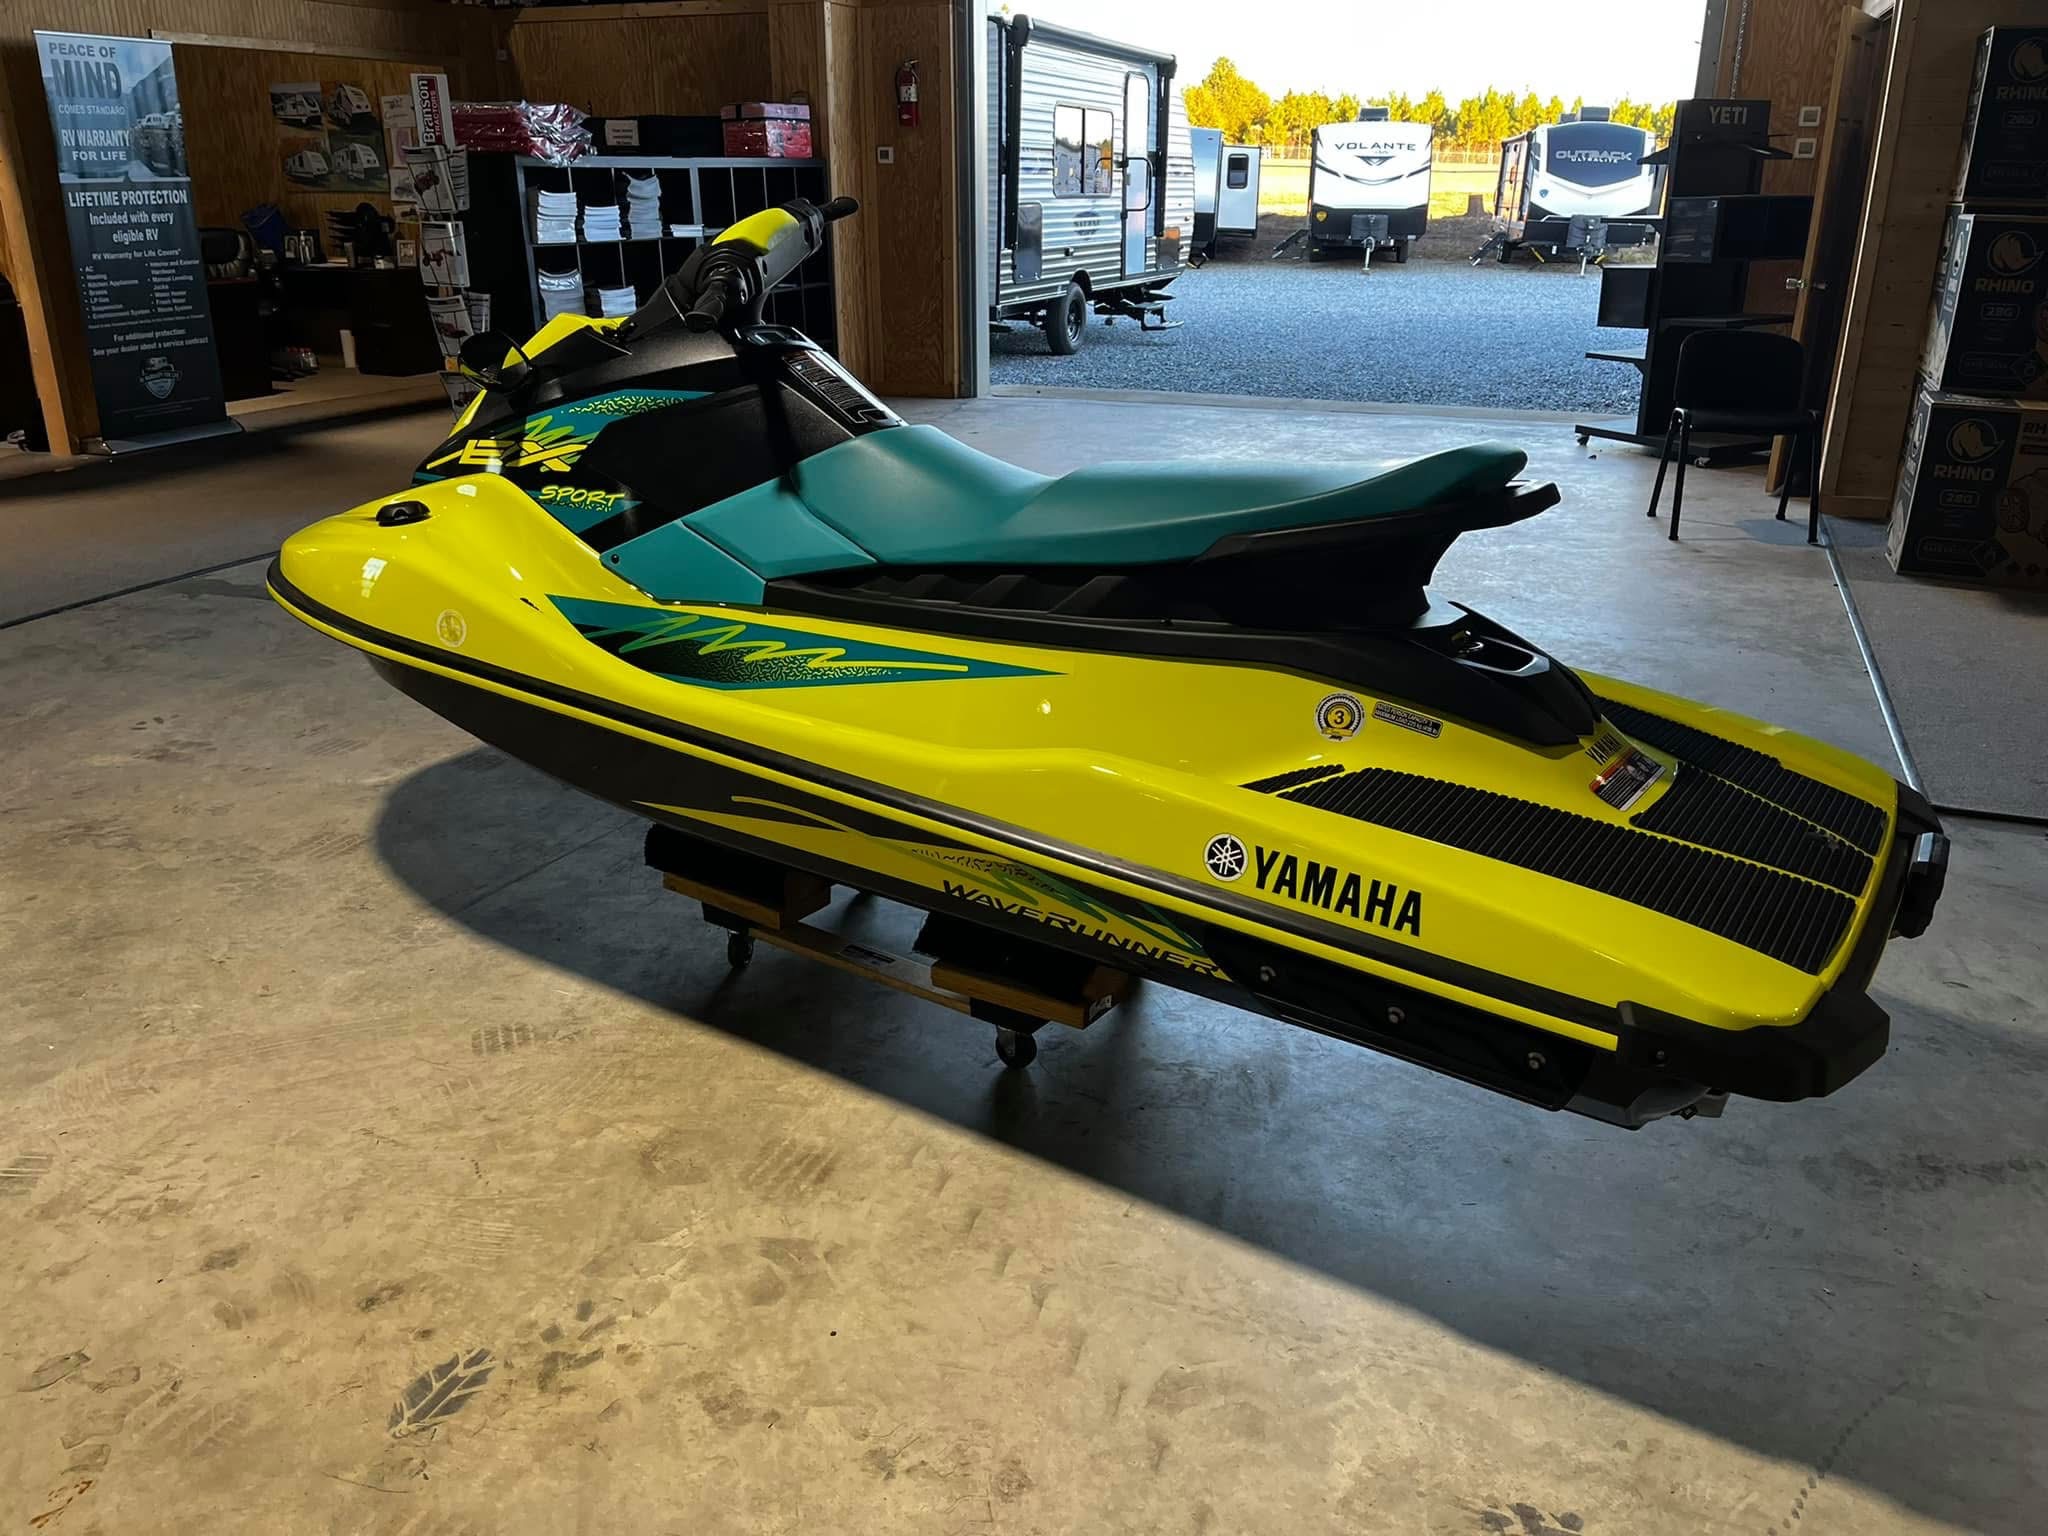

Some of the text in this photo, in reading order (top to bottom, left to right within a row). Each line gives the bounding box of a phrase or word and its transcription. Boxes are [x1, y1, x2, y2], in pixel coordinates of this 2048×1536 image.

[49, 42, 116, 58] PEACE OF
[51, 59, 121, 99] MIND
[58, 104, 126, 116] COMES STANDARD
[417, 79, 436, 143] Branson
[431, 90, 442, 136] TRACTORS
[1709, 106, 1748, 125] YETI
[61, 129, 130, 147] RV WARRANTY
[1334, 142, 1417, 152] VOLANTE
[1556, 149, 1632, 161] OUTBACK
[72, 151, 127, 161] FOR LIFE
[68, 189, 188, 207] LIFETIME PROTECTION
[89, 211, 174, 225] Included with every
[113, 228, 159, 245] eligible RV
[1975, 278, 2034, 294] RHINO
[458, 439, 589, 473] EX
[1933, 464, 1995, 481] RHINO
[539, 484, 625, 507] SPORT
[1334, 710, 1345, 725] 3
[1255, 845, 1421, 937] YAMAHA
[943, 879, 1218, 977] WAVERUNNER
